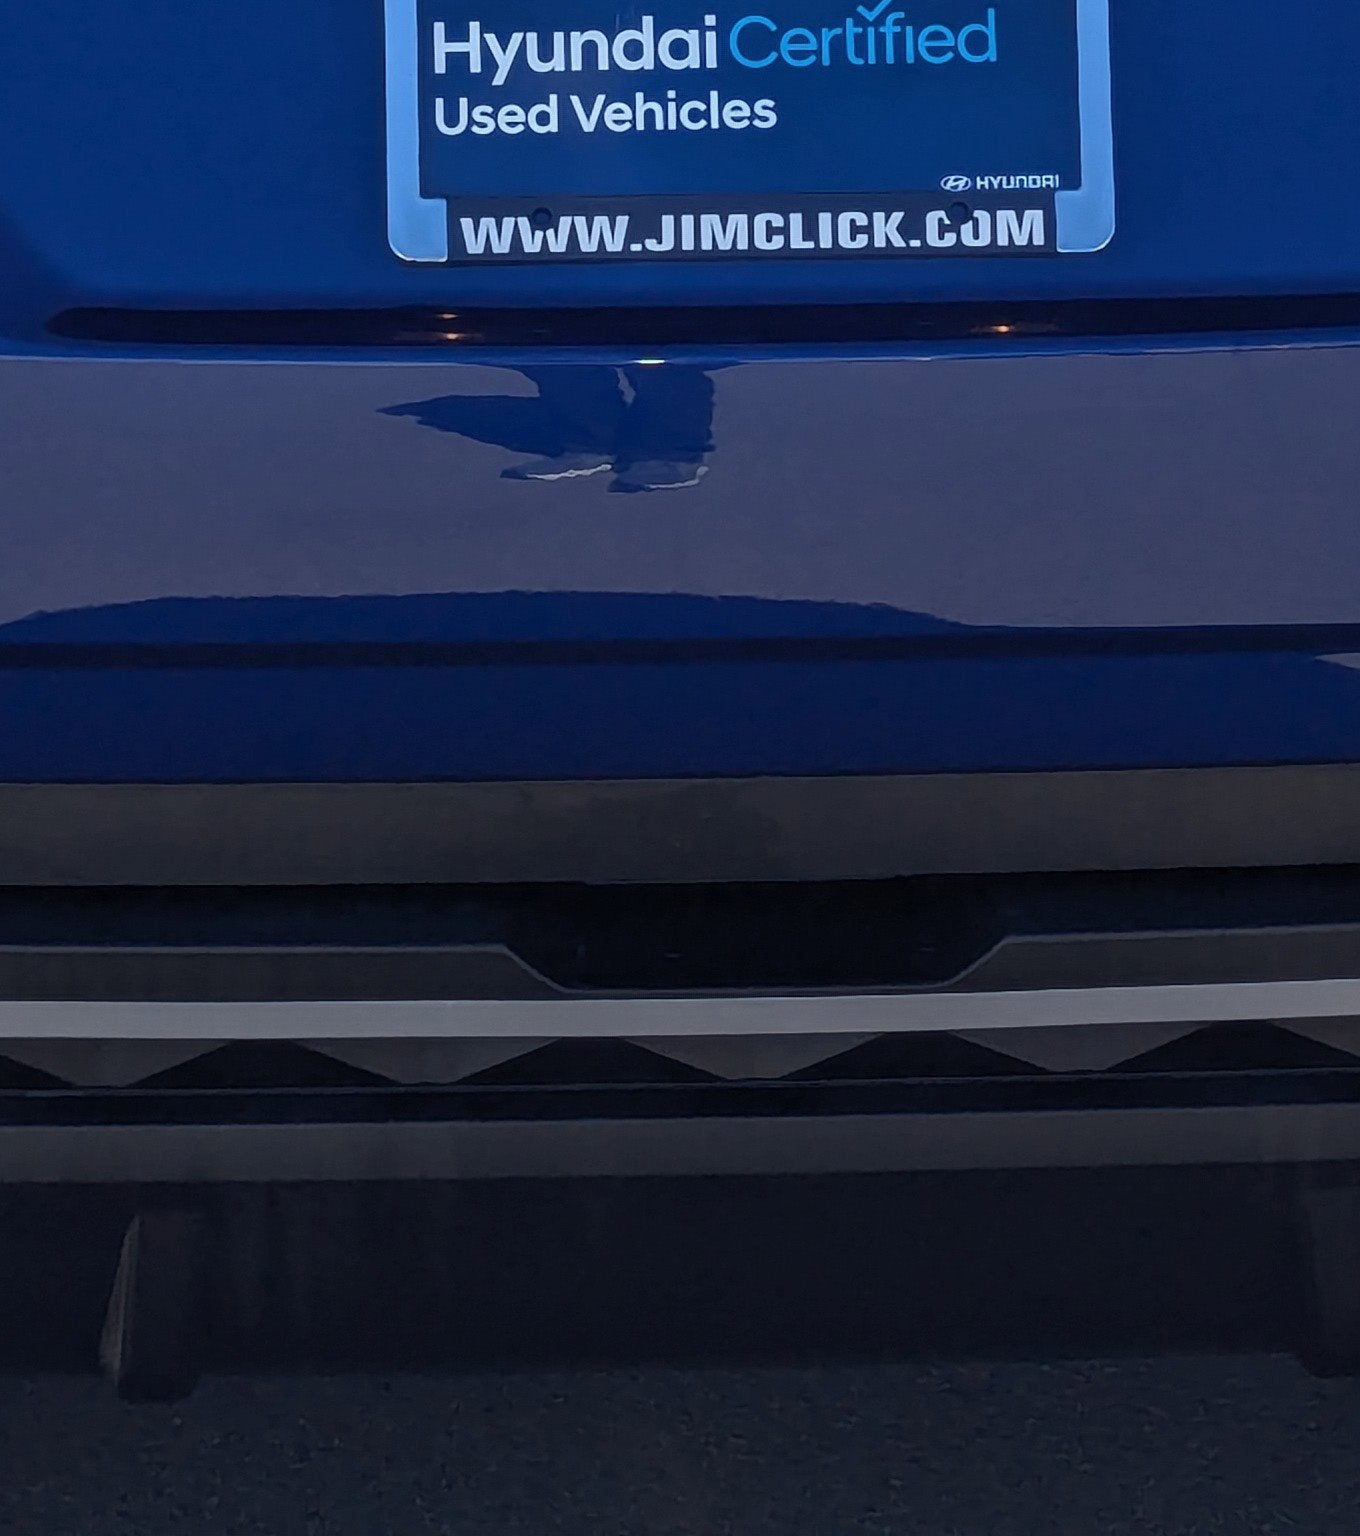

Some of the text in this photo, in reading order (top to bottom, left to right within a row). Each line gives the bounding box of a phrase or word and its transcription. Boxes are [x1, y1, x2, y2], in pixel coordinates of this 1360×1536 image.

[433, 15, 718, 85] Hyundai
[434, 90, 778, 135] Used Vehicles
[976, 174, 1060, 190] HYUNDAI
[460, 208, 1045, 255] WWW.JIMCLICK.COM
